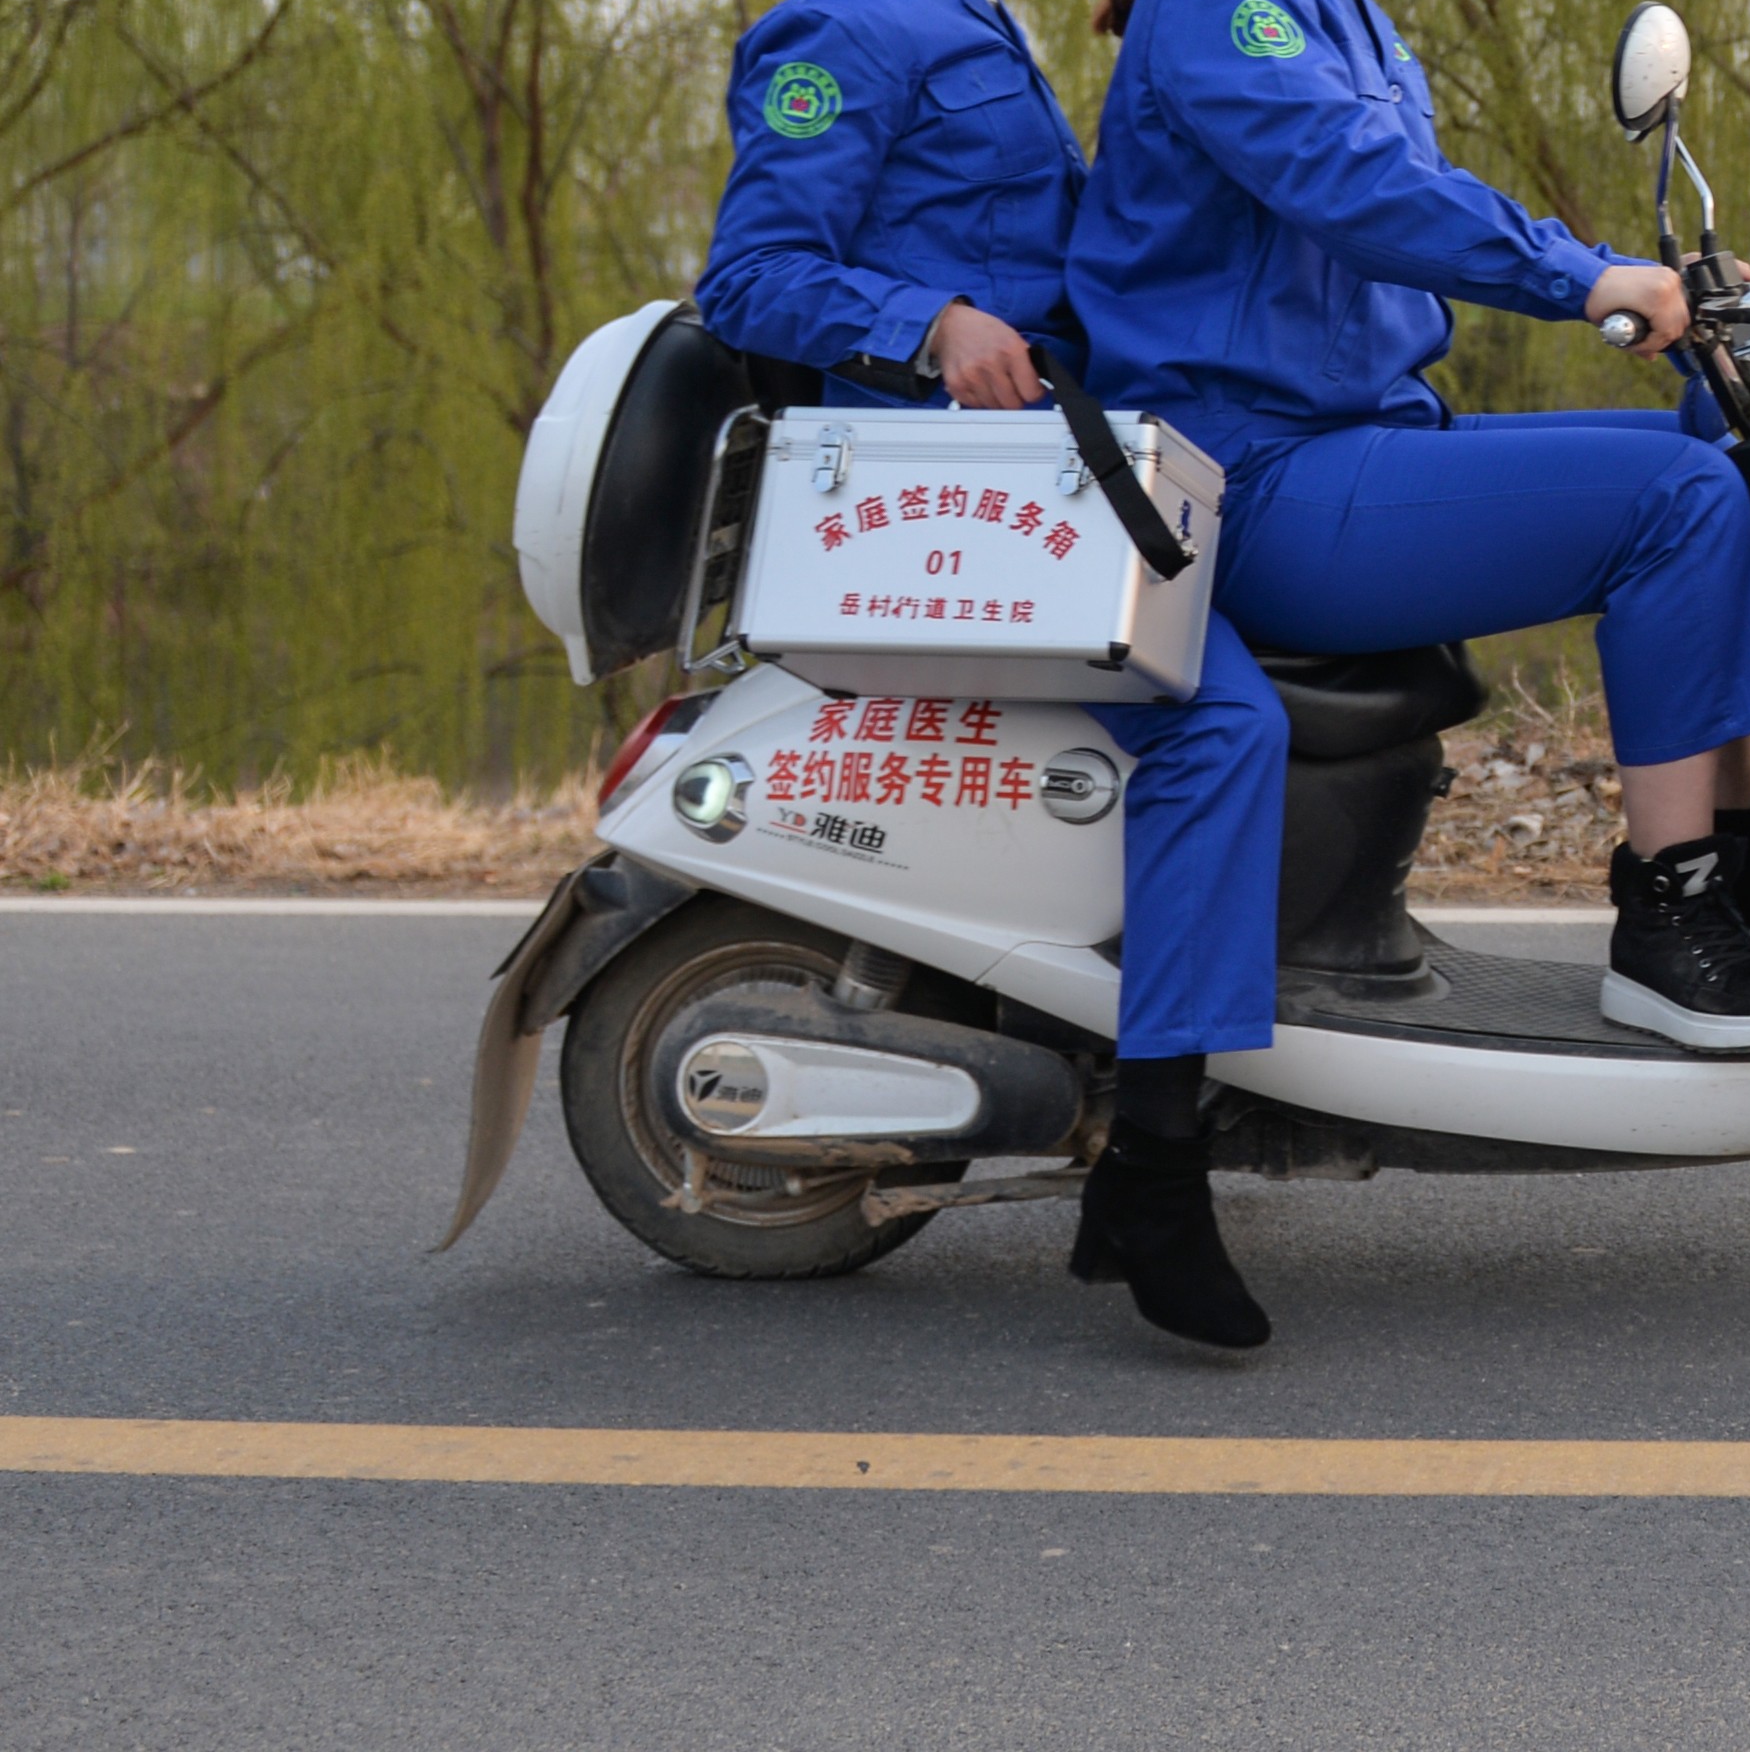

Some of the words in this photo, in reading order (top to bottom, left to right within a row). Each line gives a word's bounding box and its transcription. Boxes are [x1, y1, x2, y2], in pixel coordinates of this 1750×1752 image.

[814, 485, 1080, 560] 家庭签约服务箱
[925, 550, 962, 575] 01
[809, 698, 1003, 746] 家庭医生
[765, 749, 1036, 810] 签约服务专用车
[810, 811, 888, 854] 雅迪
